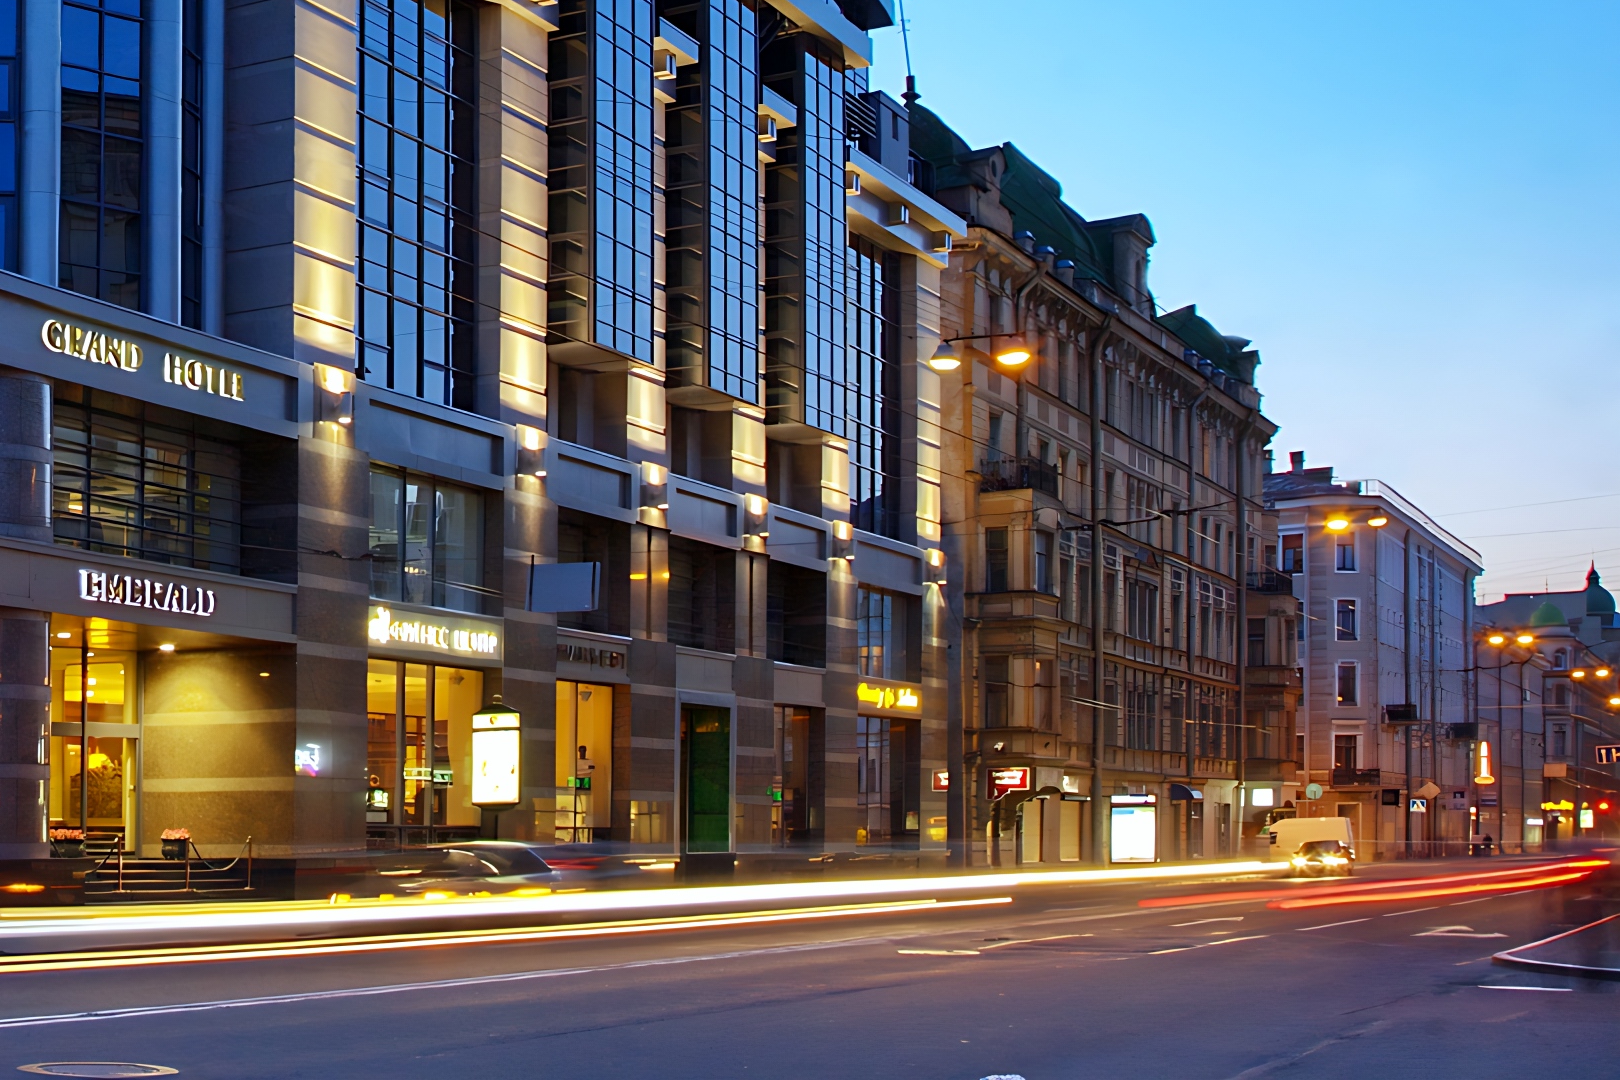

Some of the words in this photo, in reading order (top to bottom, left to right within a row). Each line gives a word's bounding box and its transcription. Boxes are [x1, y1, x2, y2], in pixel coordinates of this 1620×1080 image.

[41, 319, 143, 372] GRAND
[164, 352, 245, 401] HOTEL
[78, 569, 216, 616] EMERALD
